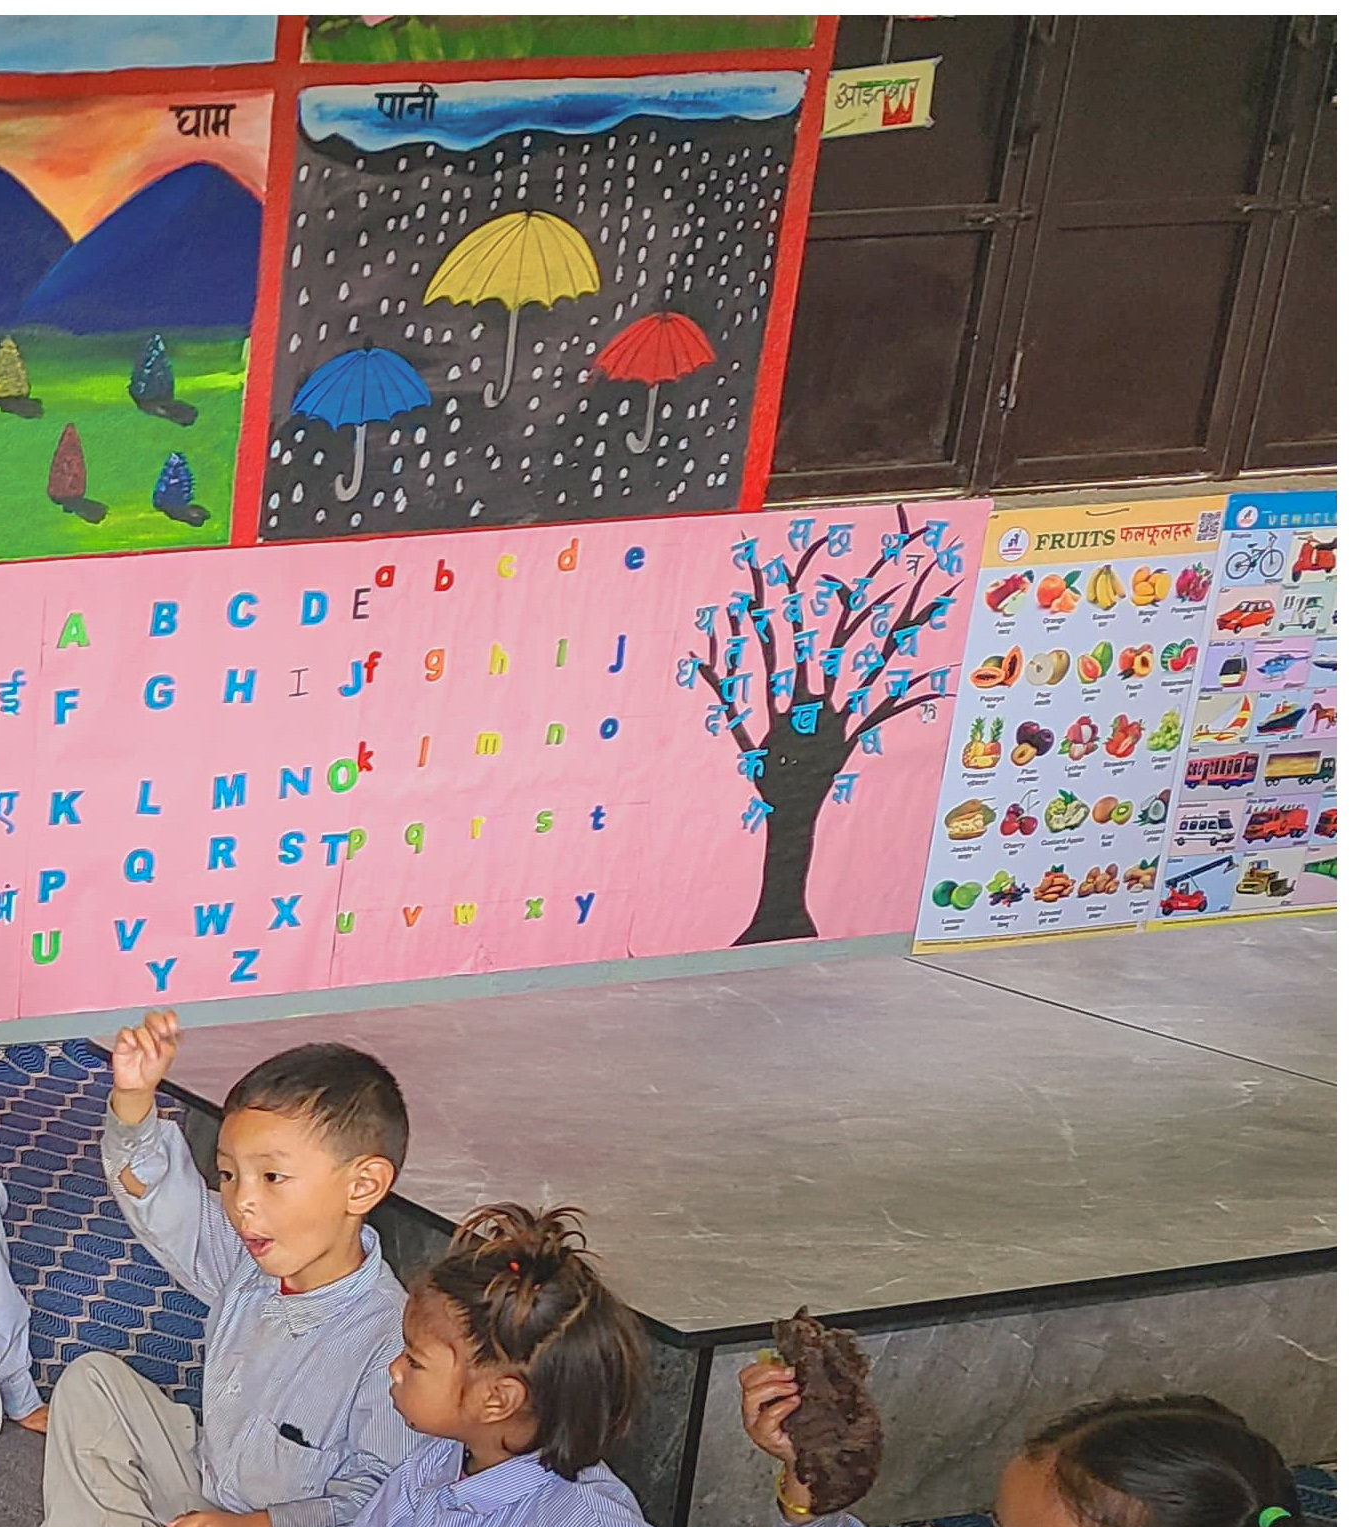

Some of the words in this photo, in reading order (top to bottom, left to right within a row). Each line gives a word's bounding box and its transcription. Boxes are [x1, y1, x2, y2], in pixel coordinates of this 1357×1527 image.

[169, 103, 237, 137] घाम
[374, 83, 441, 122] पानी
[373, 563, 398, 590] a
[433, 558, 456, 592] b
[494, 552, 518, 580] c
[557, 538, 581, 572] d
[624, 546, 646, 572] e
[1034, 530, 1116, 551] FRUITS
[57, 612, 90, 649] A
[150, 600, 180, 638] B
[226, 590, 260, 630] C
[300, 590, 330, 628] D
[352, 587, 372, 620] E
[363, 649, 384, 685] f
[424, 647, 447, 682] g
[488, 641, 511, 676] h
[608, 634, 628, 676] j
[53, 688, 82, 726] F
[143, 674, 176, 712] G
[222, 666, 258, 704] H
[288, 666, 311, 698] I
[338, 659, 366, 698] J
[788, 701, 825, 735] ख
[357, 741, 375, 772] k
[474, 730, 504, 756] m
[546, 721, 566, 746] n
[599, 717, 622, 742] o
[48, 788, 84, 826] K
[136, 778, 164, 816] L
[212, 771, 248, 811] M
[279, 765, 314, 800] N
[327, 757, 360, 795] O
[346, 827, 368, 861] p
[405, 822, 427, 853] q
[469, 815, 487, 839] r
[536, 809, 555, 834] s
[589, 804, 608, 832] t
[36, 868, 68, 904] P
[122, 847, 156, 885] Q
[206, 834, 238, 872] R
[280, 830, 308, 866] S
[319, 830, 349, 868] T
[31, 929, 62, 966] U
[115, 916, 146, 954] V
[194, 900, 235, 938] W
[269, 894, 303, 931] X
[337, 912, 357, 935] u
[401, 903, 424, 929] v
[451, 901, 479, 928] w
[524, 896, 546, 921] x
[575, 892, 596, 924] y
[147, 957, 179, 992] Y
[228, 948, 261, 984] Z
